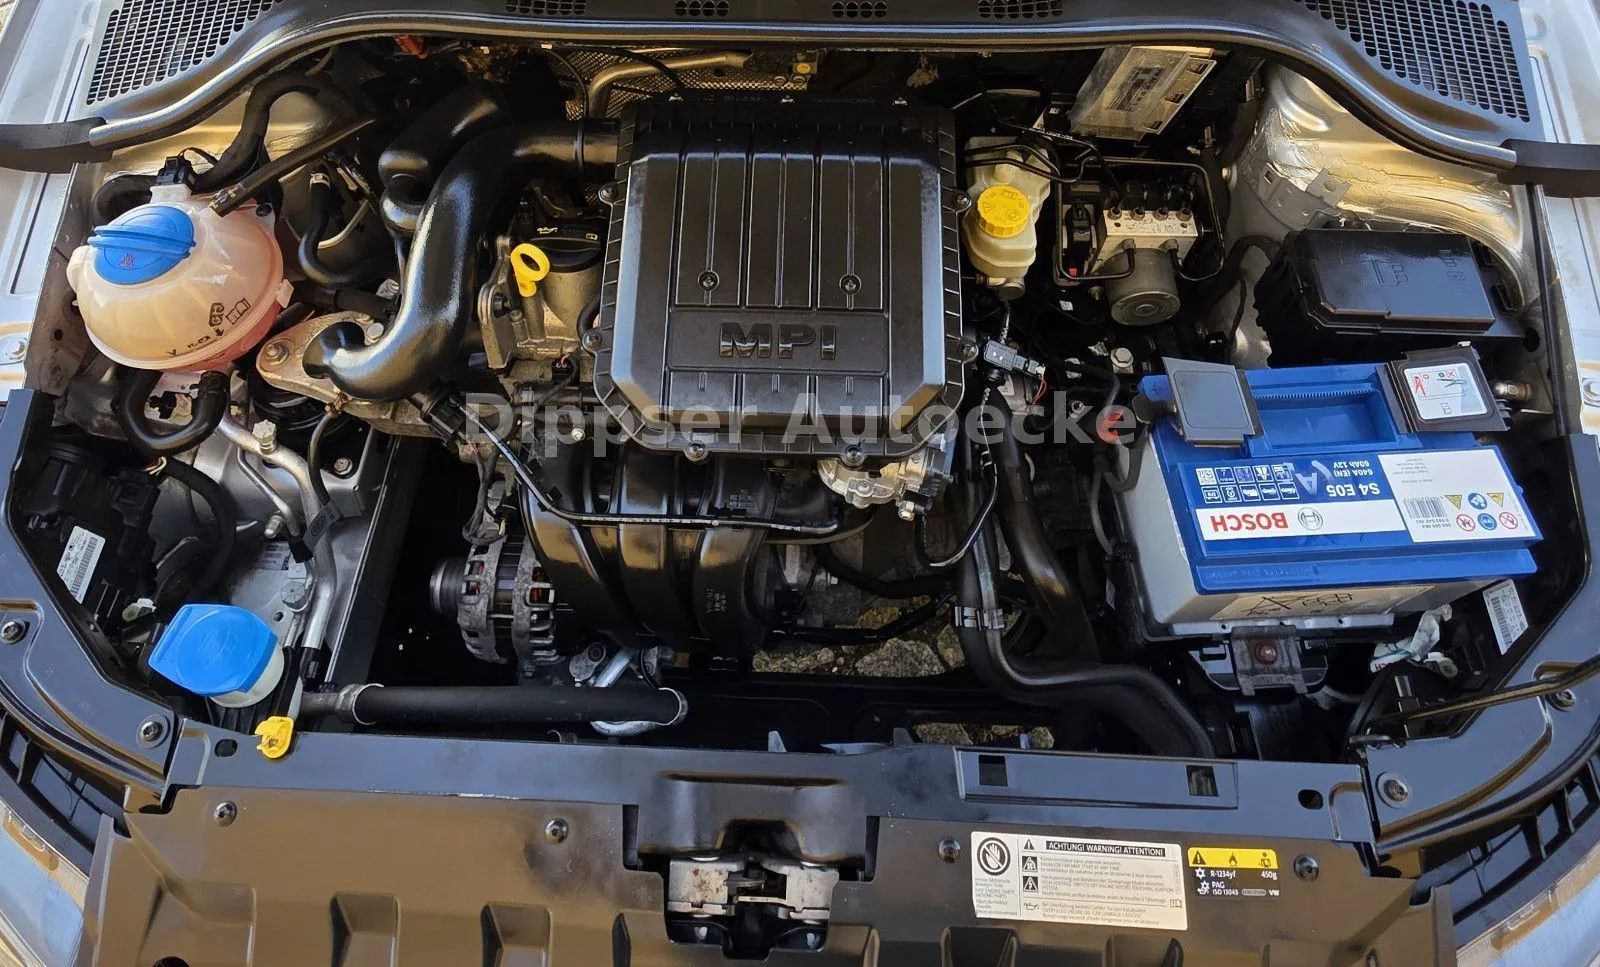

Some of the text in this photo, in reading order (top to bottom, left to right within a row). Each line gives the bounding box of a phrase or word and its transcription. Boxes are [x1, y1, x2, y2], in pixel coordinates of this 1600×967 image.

[719, 322, 837, 361] MPI
[1333, 460, 1370, 469] 60Ah 12V
[1333, 468, 1374, 478] 640A (EN)
[1326, 482, 1380, 497] S4 E05
[1210, 512, 1289, 532] BOSCH
[1048, 842, 1163, 856] ACHTUNG! WARNING! ATTENTION!
[1210, 870, 1278, 880] R-1234yf 450g
